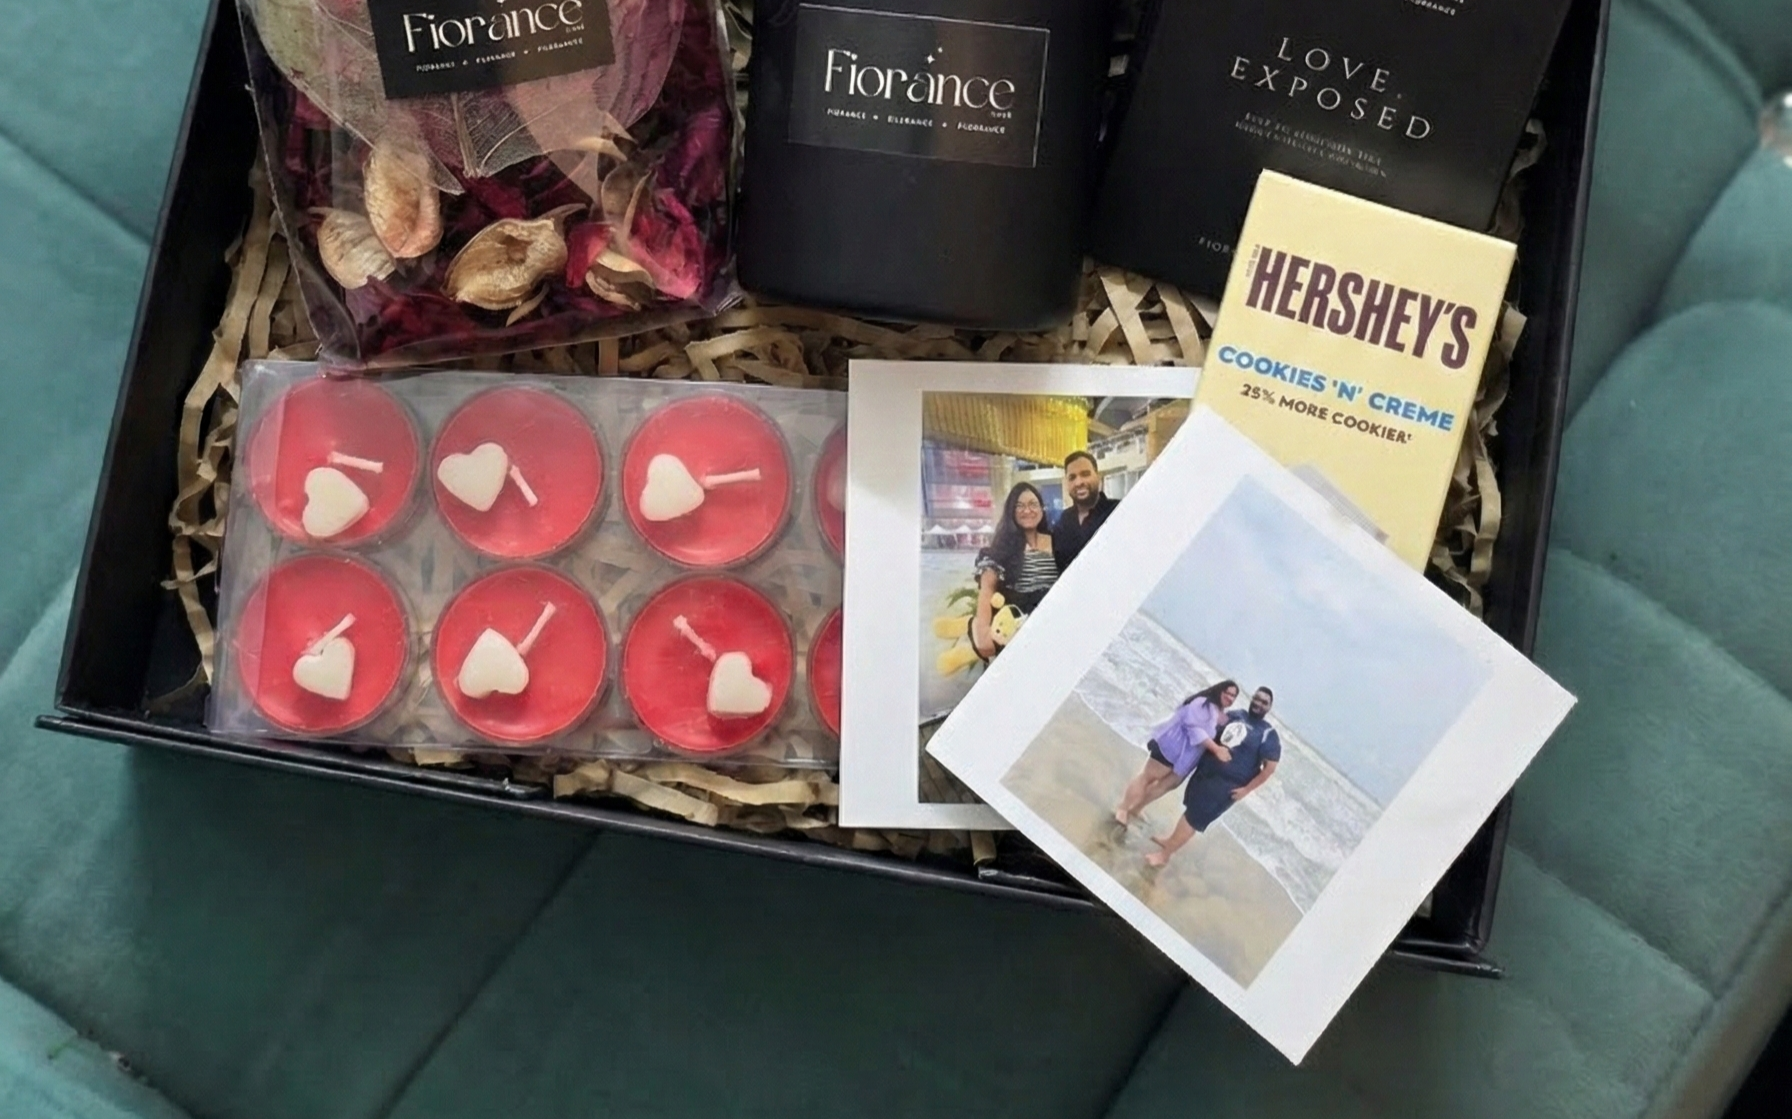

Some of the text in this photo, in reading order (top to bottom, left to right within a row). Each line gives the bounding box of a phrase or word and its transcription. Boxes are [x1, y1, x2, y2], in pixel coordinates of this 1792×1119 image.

[1230, 56, 1432, 140] EXPOSED
[1245, 245, 1478, 370] HERSHEY'S
[1218, 345, 1455, 432] COOKIES 'N' CREME
[1239, 383, 1276, 405] 25%
[1278, 395, 1329, 421] MORE
